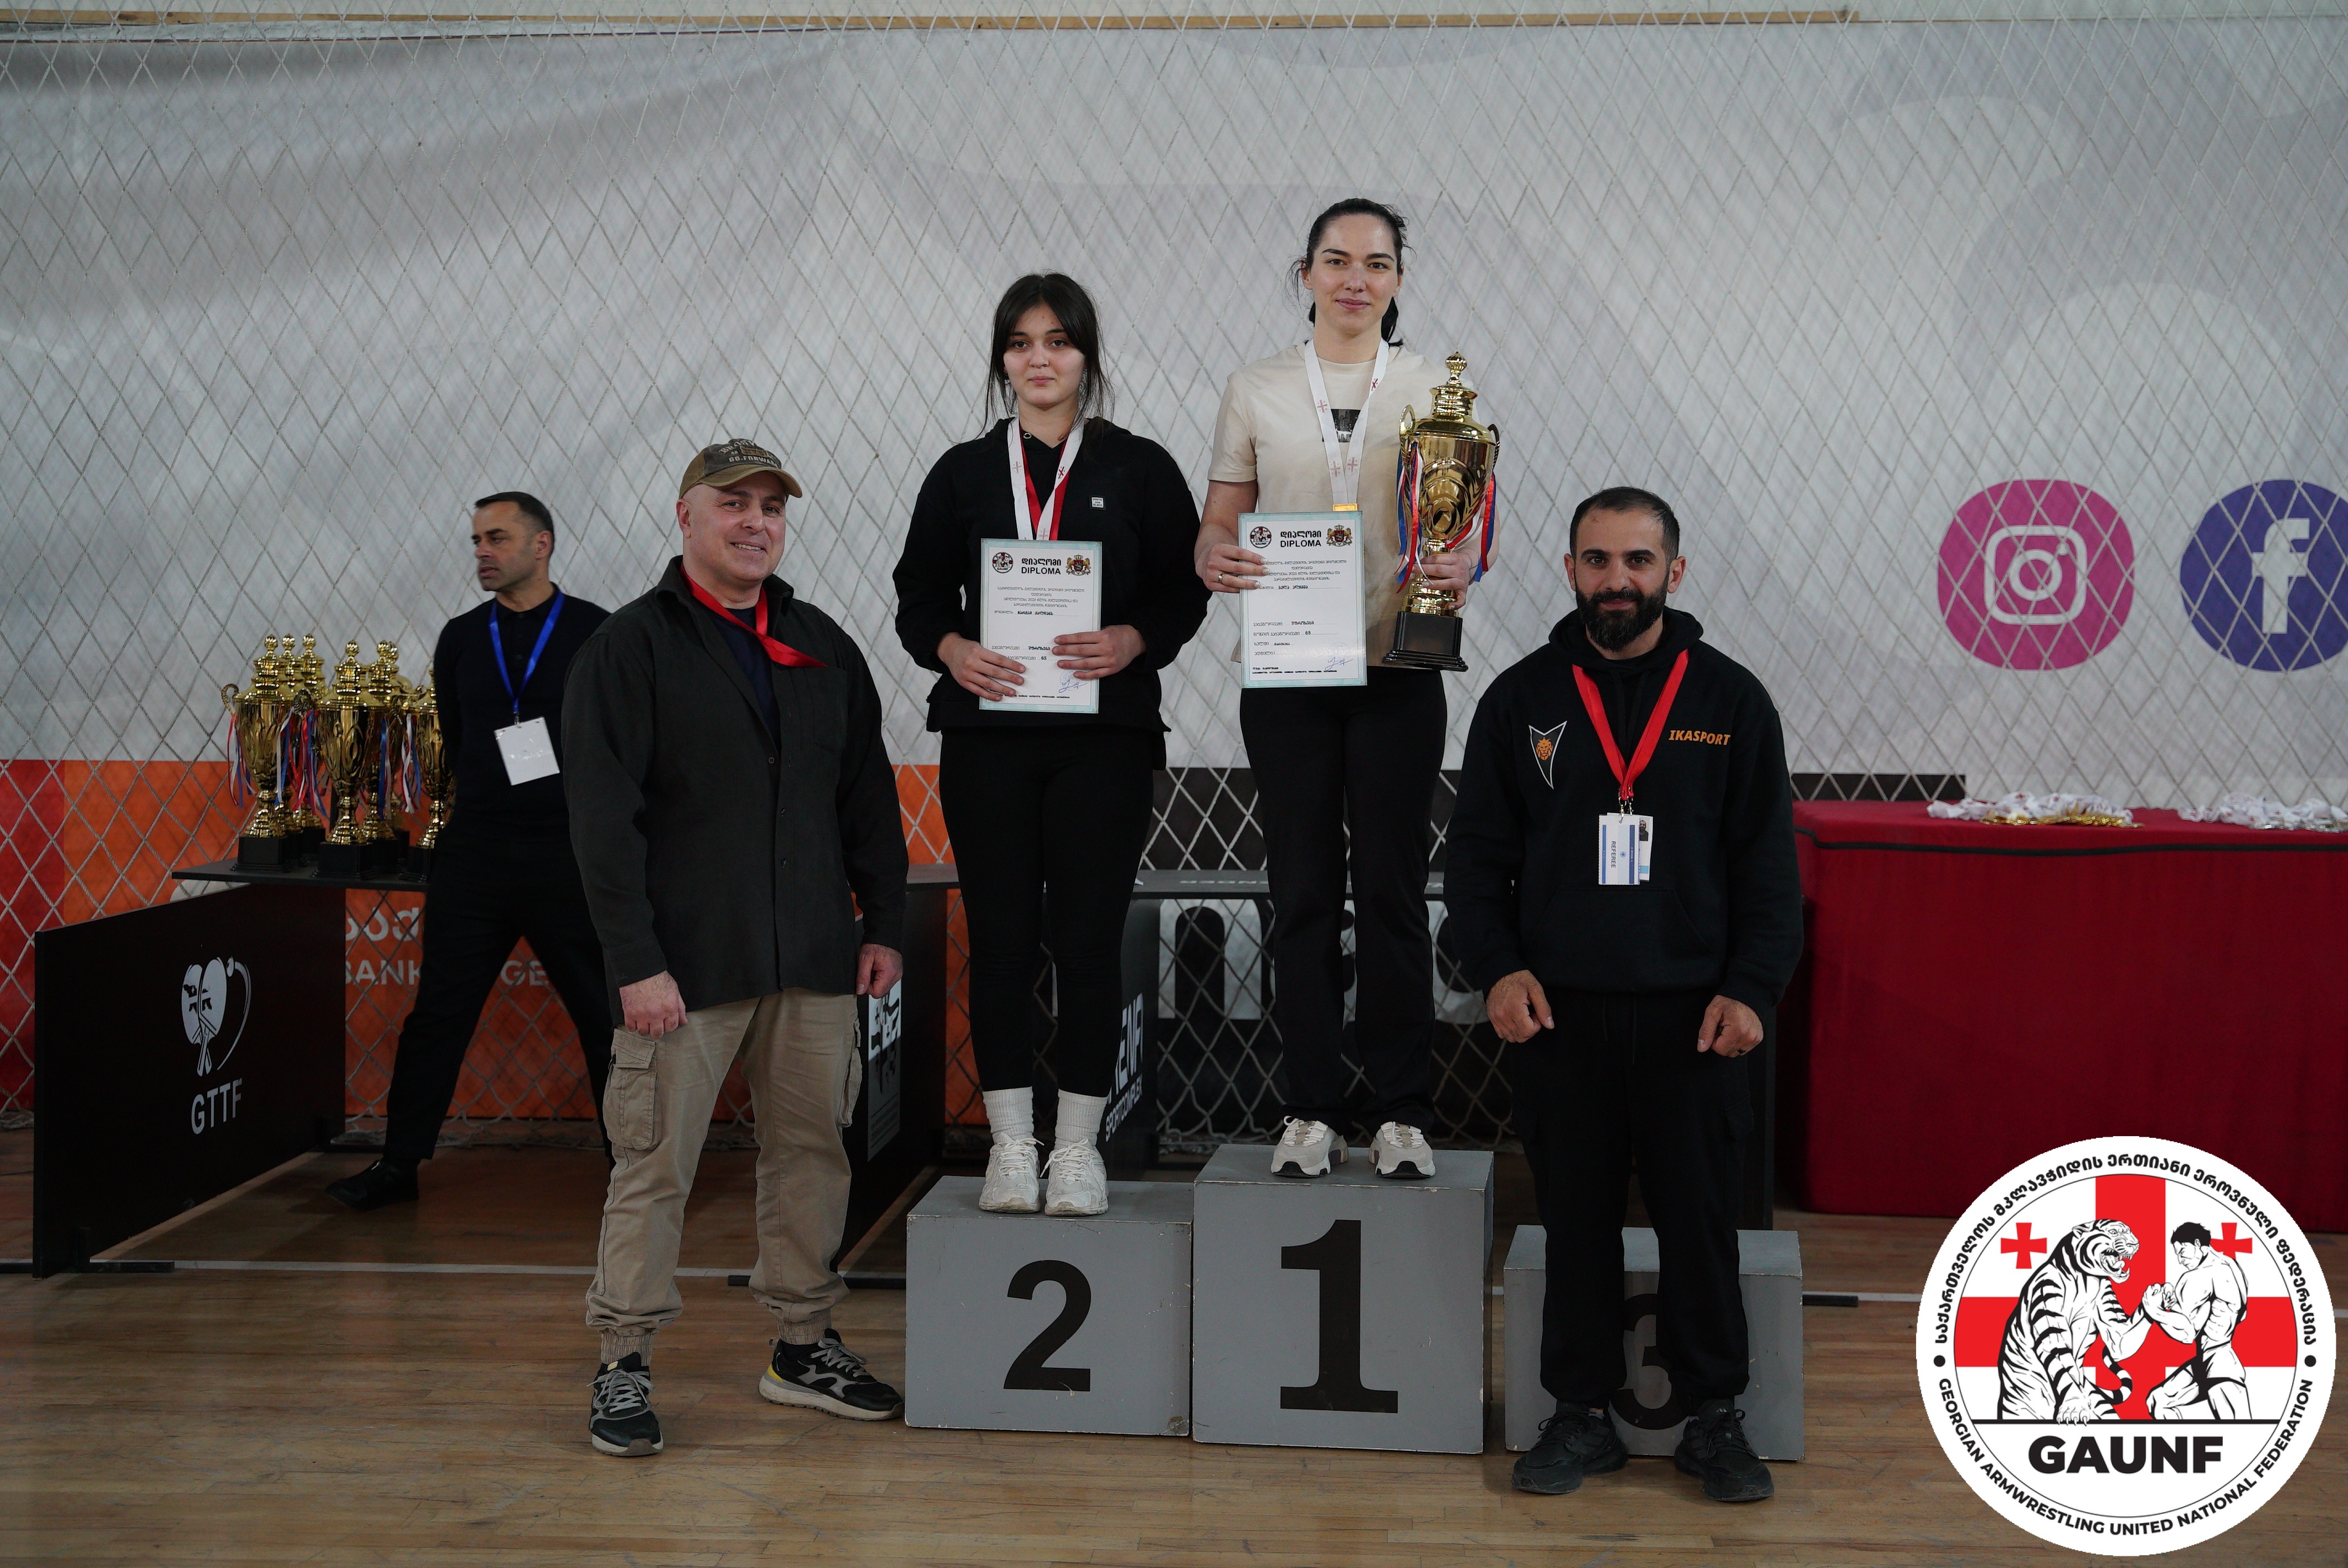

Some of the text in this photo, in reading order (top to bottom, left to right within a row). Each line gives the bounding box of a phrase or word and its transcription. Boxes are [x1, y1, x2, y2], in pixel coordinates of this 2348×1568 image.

[1280, 530, 1322, 539] დიპლომი
[1280, 539, 1322, 548] DIPLOMA
[1021, 558, 1062, 566] დიპლომი
[1021, 566, 1061, 575] DIPLOMA
[1669, 730, 1731, 746] IKASPORT
[191, 1078, 243, 1135] GTTF
[1280, 1219, 1398, 1414] 1
[1003, 1260, 1091, 1392] 2
